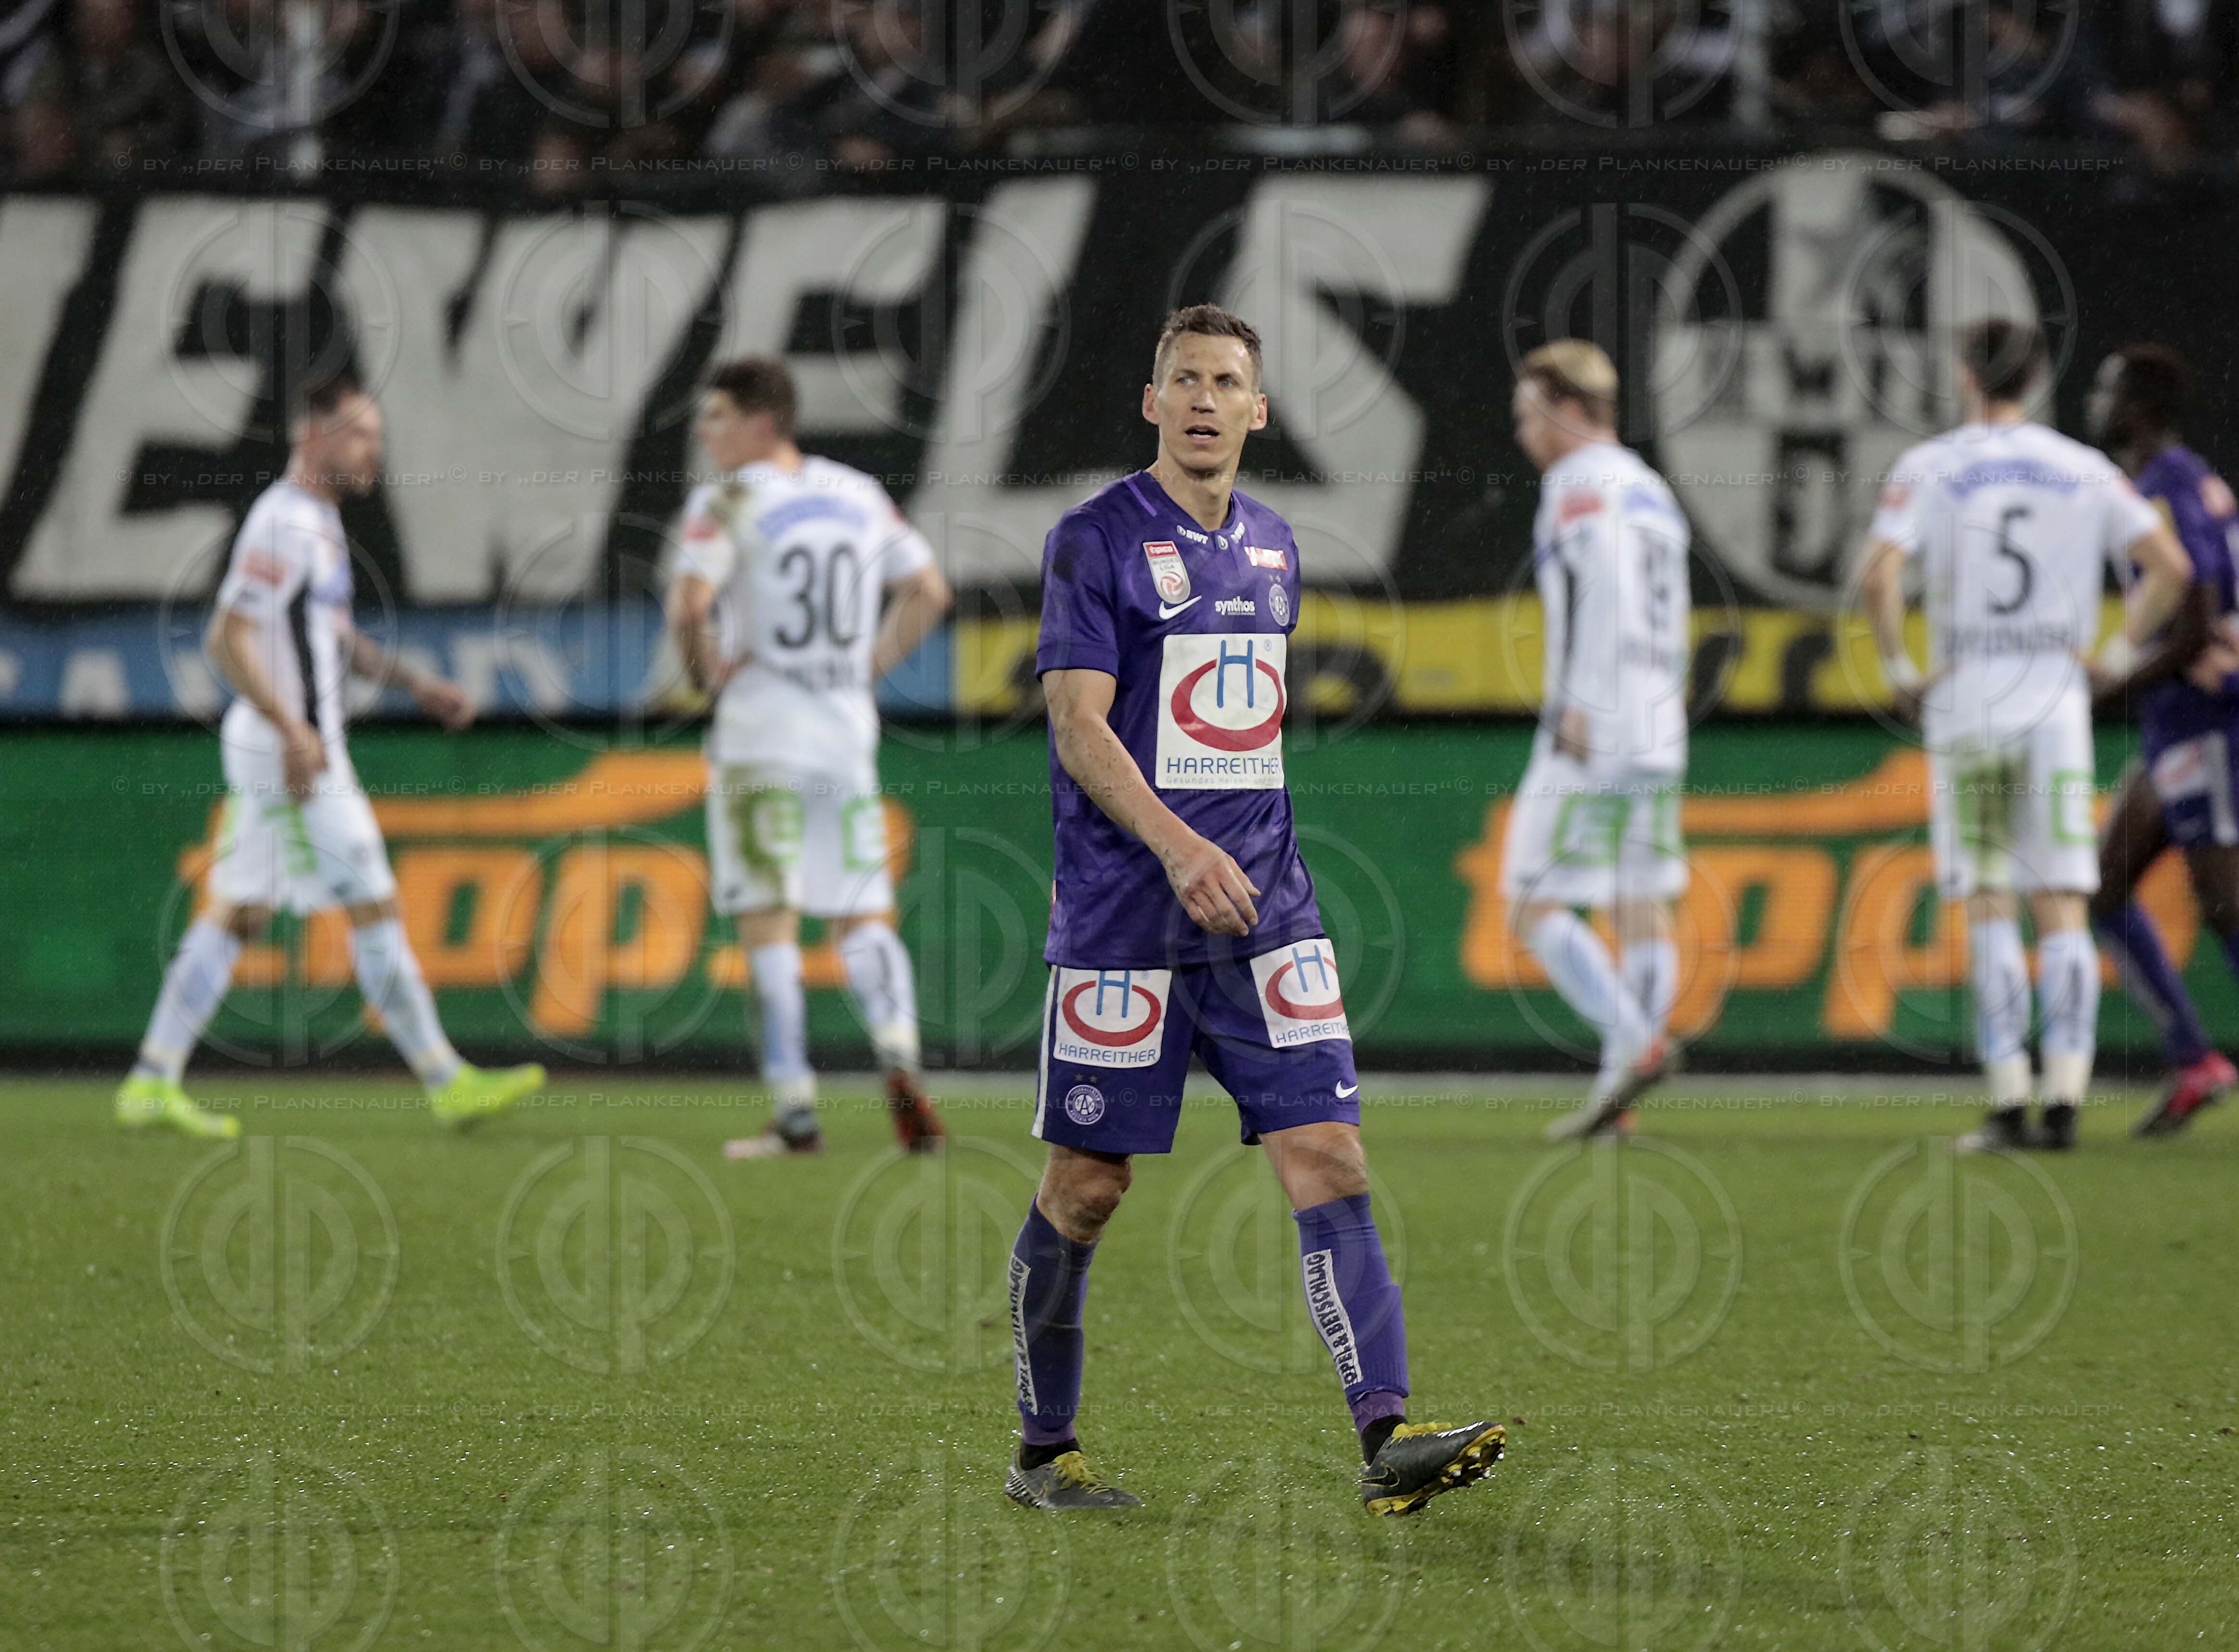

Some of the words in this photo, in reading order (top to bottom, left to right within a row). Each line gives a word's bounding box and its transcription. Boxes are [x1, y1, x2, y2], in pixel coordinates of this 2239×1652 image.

[0, 175, 1489, 603] EWELS
[1986, 504, 2034, 616] 5
[774, 544, 862, 649] 30
[1215, 596, 1256, 616] synthos
[1167, 757, 1281, 775] HARREITHER
[1276, 1022, 1350, 1043] HARREITH
[1059, 1043, 1156, 1064] HARREITHER
